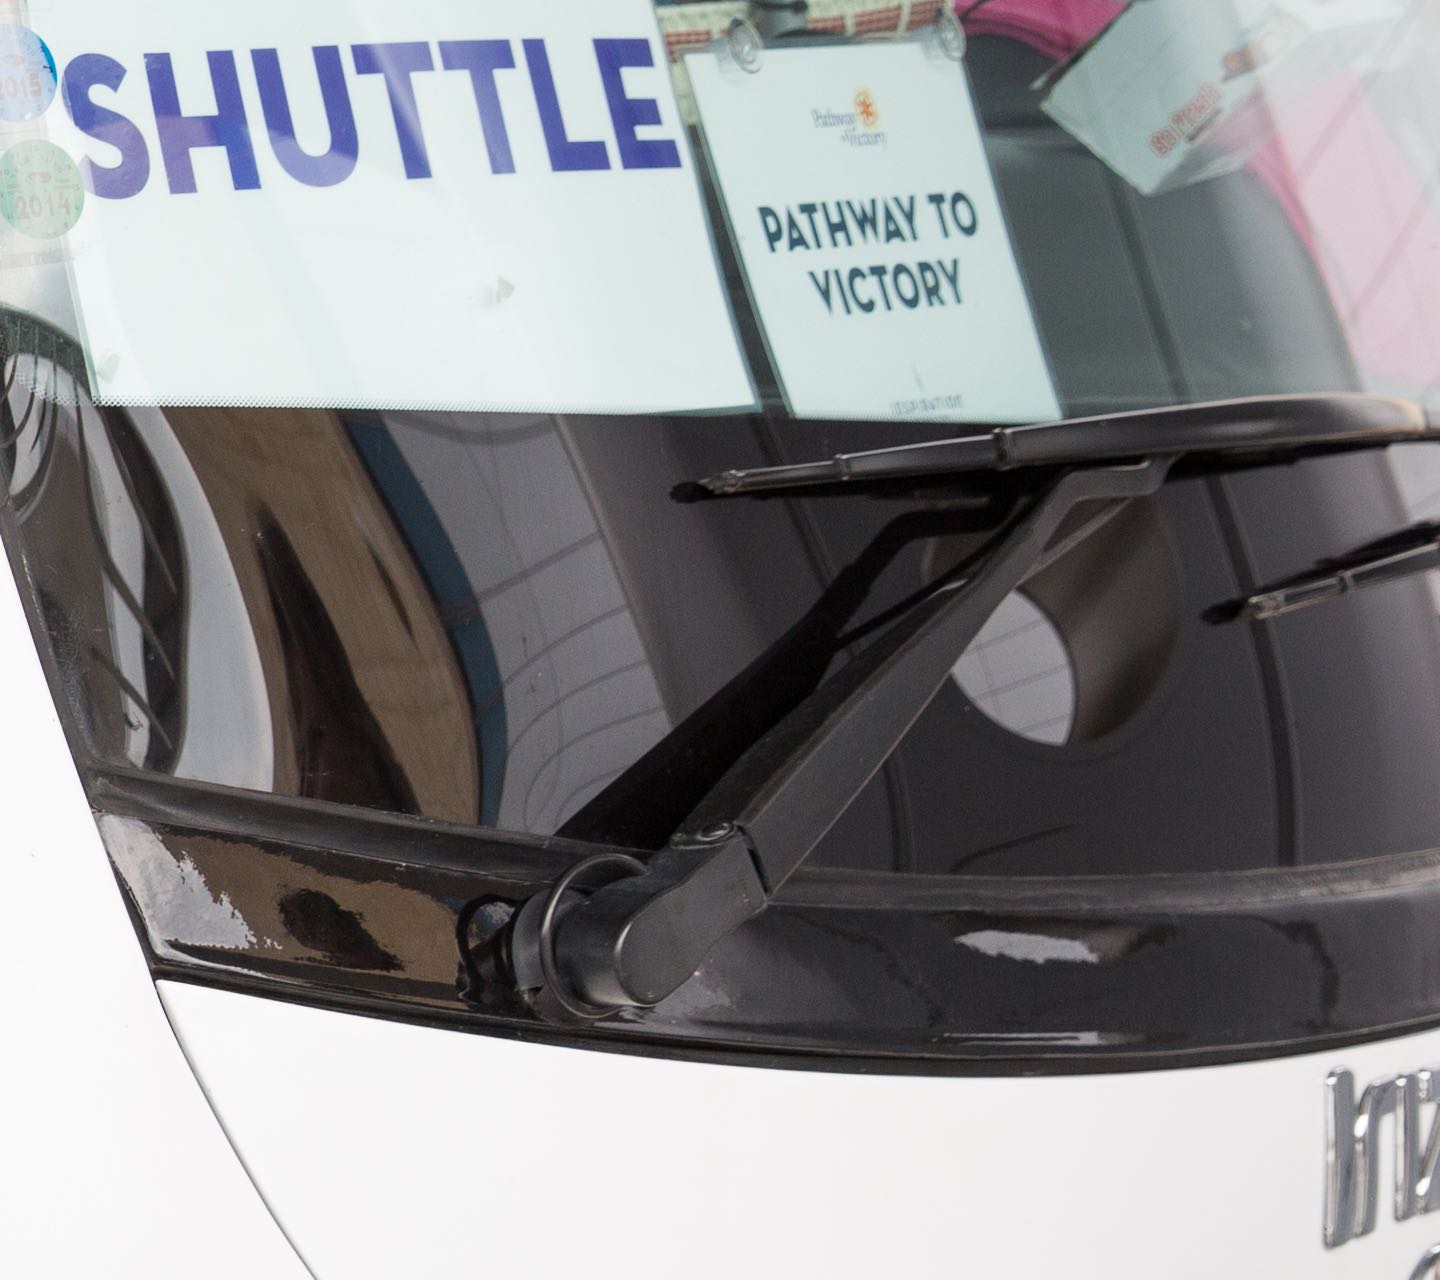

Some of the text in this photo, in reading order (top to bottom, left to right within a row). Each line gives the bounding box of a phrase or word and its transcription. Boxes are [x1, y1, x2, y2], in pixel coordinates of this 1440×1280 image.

[61, 38, 683, 200] SHUTTLE
[16, 193, 71, 220] 2014
[757, 191, 978, 253] PATHWAY TO
[808, 257, 962, 315] VICTORY
